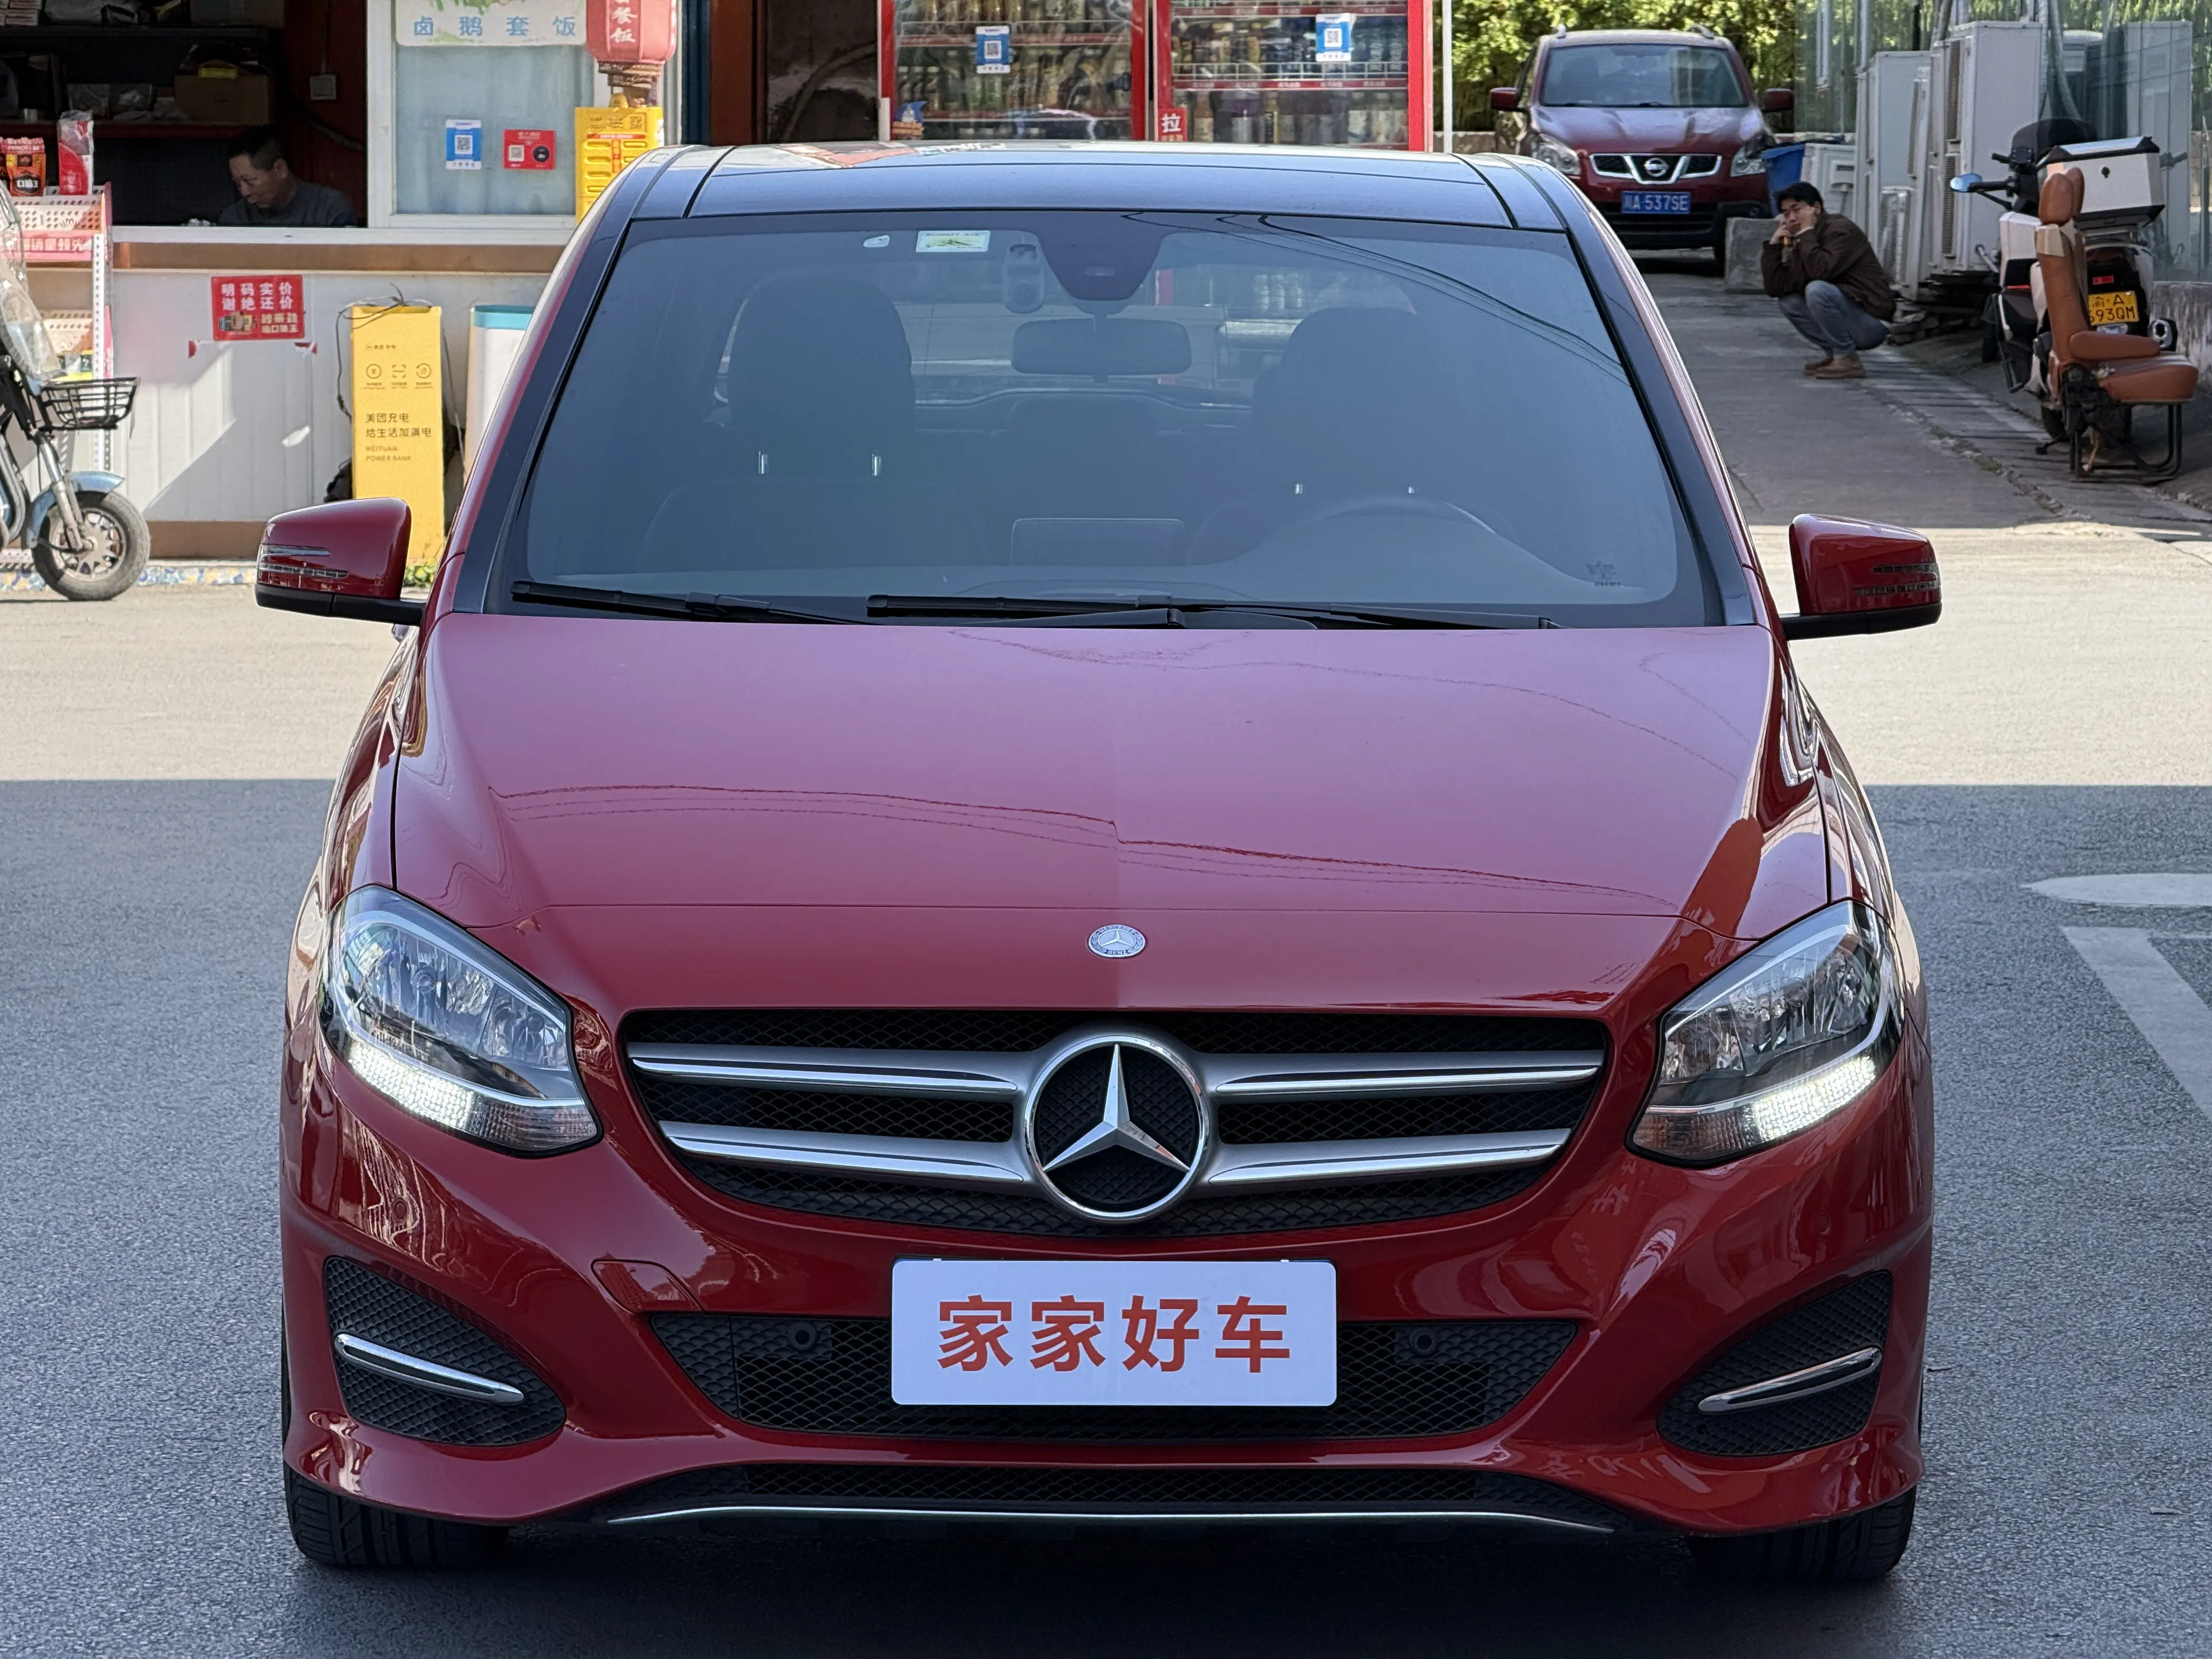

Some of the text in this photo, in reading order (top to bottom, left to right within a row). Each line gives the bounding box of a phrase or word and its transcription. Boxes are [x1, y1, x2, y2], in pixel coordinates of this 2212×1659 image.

[414, 15, 575, 37] 卤鹅套饭
[1161, 113, 1181, 133] 拉
[221, 282, 292, 297] 明码实价
[222, 296, 293, 311] 谢绝还价
[937, 1295, 1290, 1373] 家家好车
